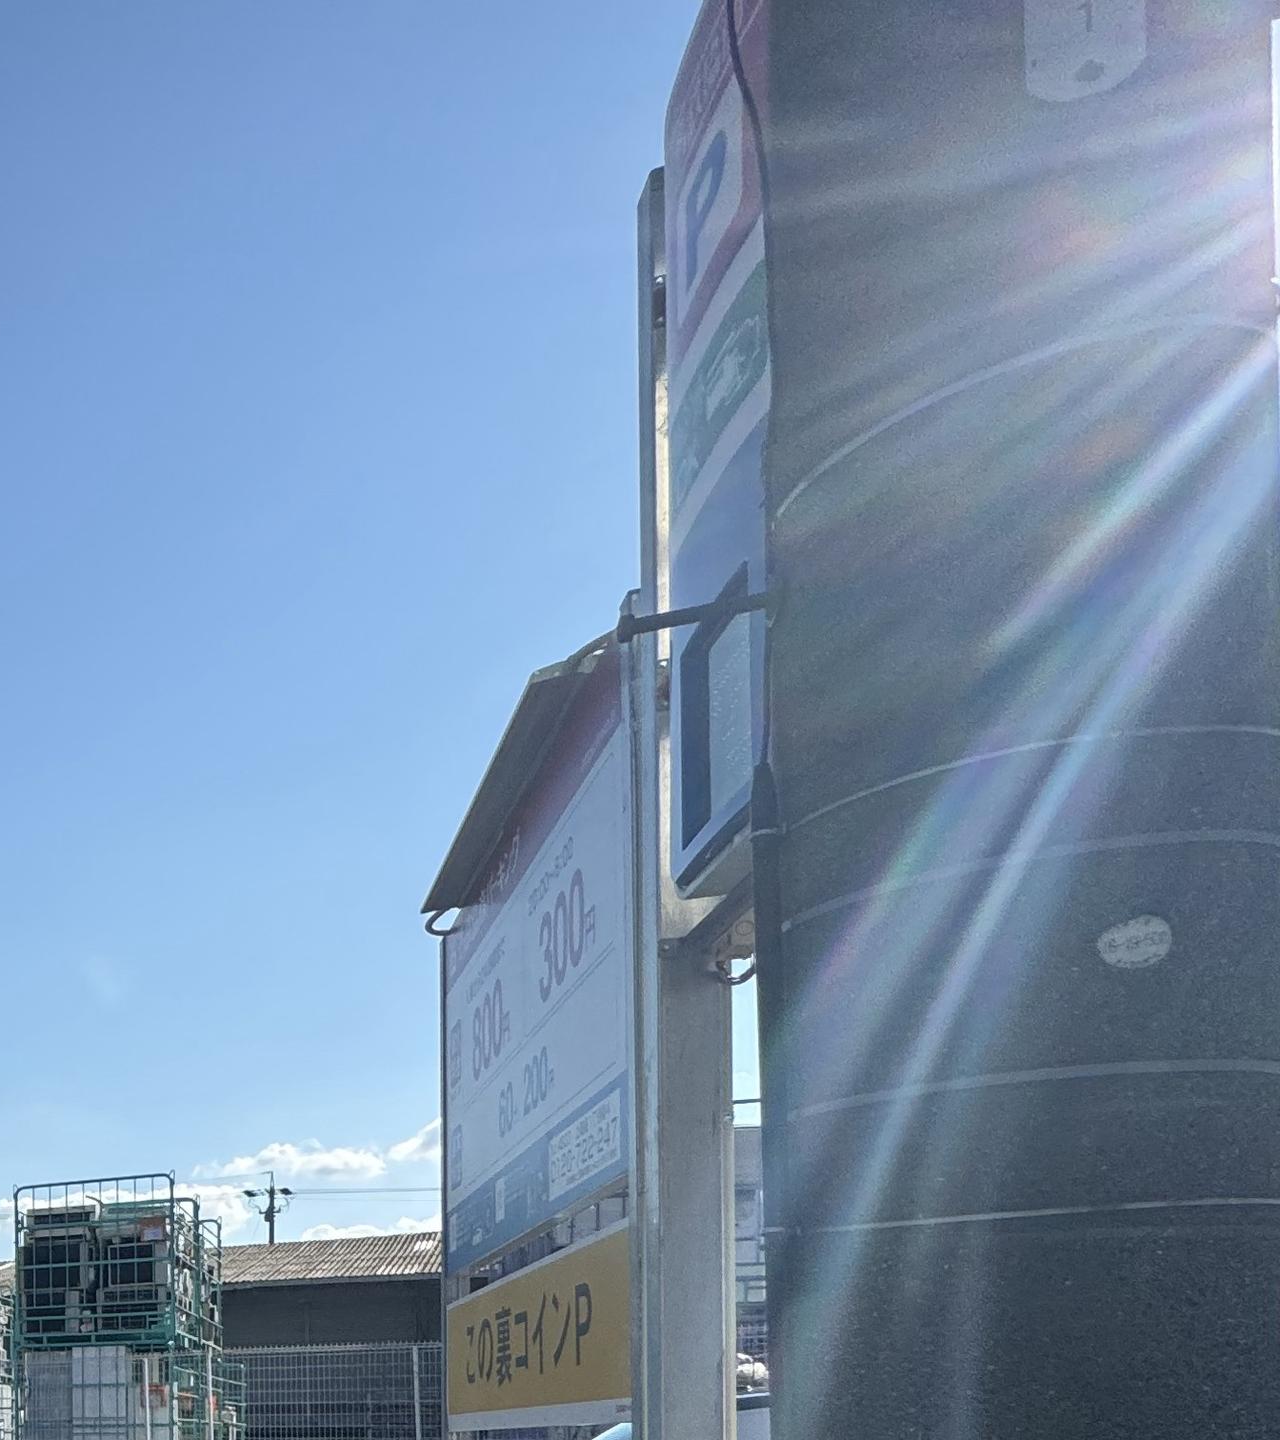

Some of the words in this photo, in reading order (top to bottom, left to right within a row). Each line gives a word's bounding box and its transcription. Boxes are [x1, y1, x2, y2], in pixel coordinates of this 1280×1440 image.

[686, 129, 728, 290] P
[466, 1283, 593, 1388] この裏コインP
